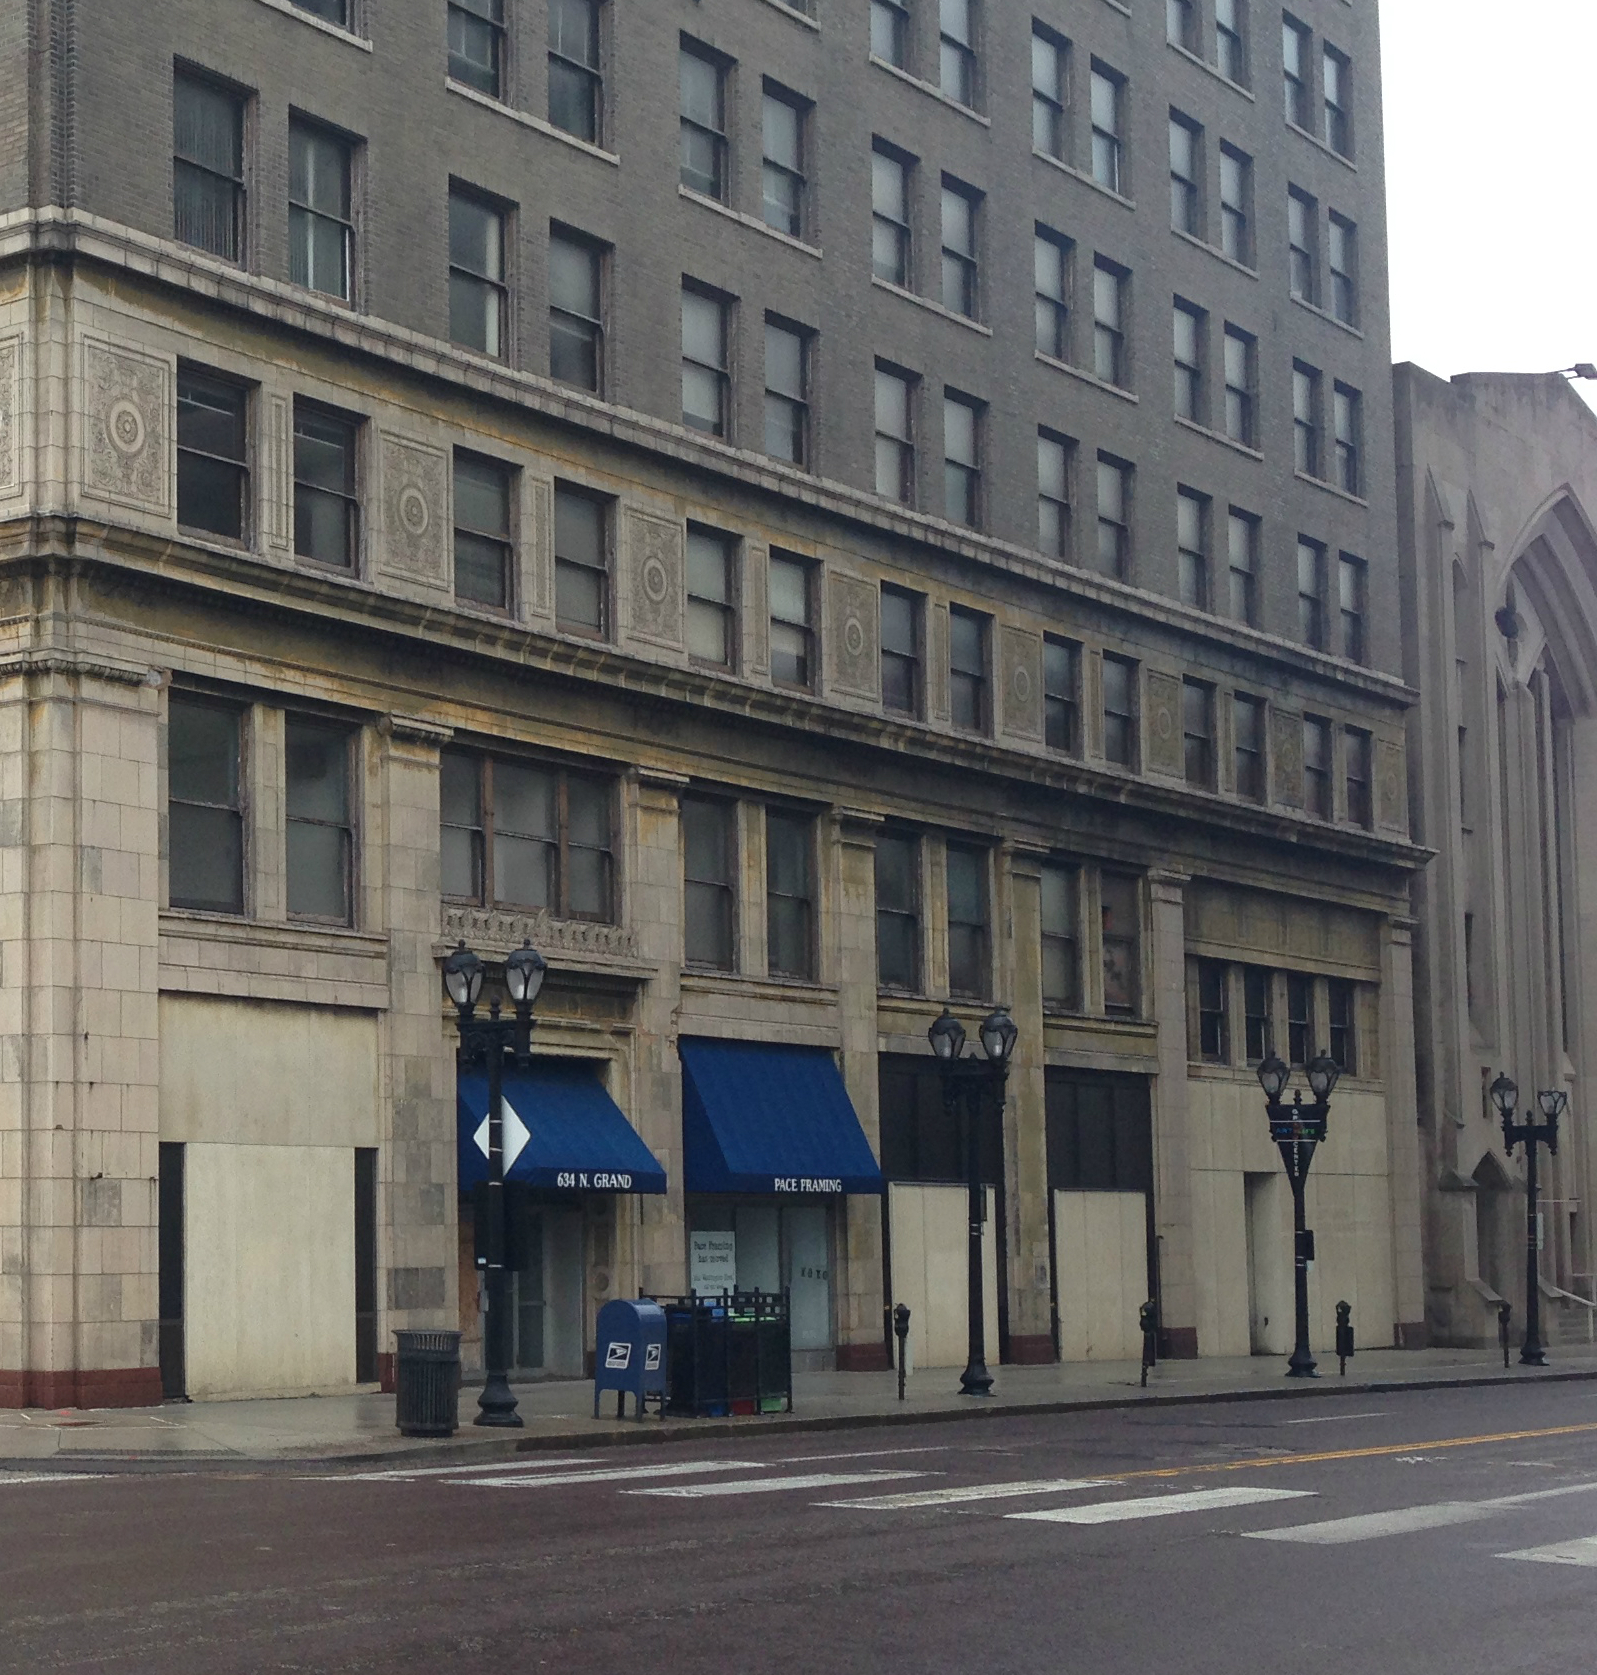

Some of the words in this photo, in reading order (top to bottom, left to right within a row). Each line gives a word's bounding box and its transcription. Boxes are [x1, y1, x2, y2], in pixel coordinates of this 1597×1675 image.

[557, 1172, 575, 1188] 634
[579, 1173, 591, 1188] N.
[593, 1173, 632, 1189] GRAND
[774, 1178, 798, 1192] PACE
[800, 1178, 842, 1193] FRAMING
